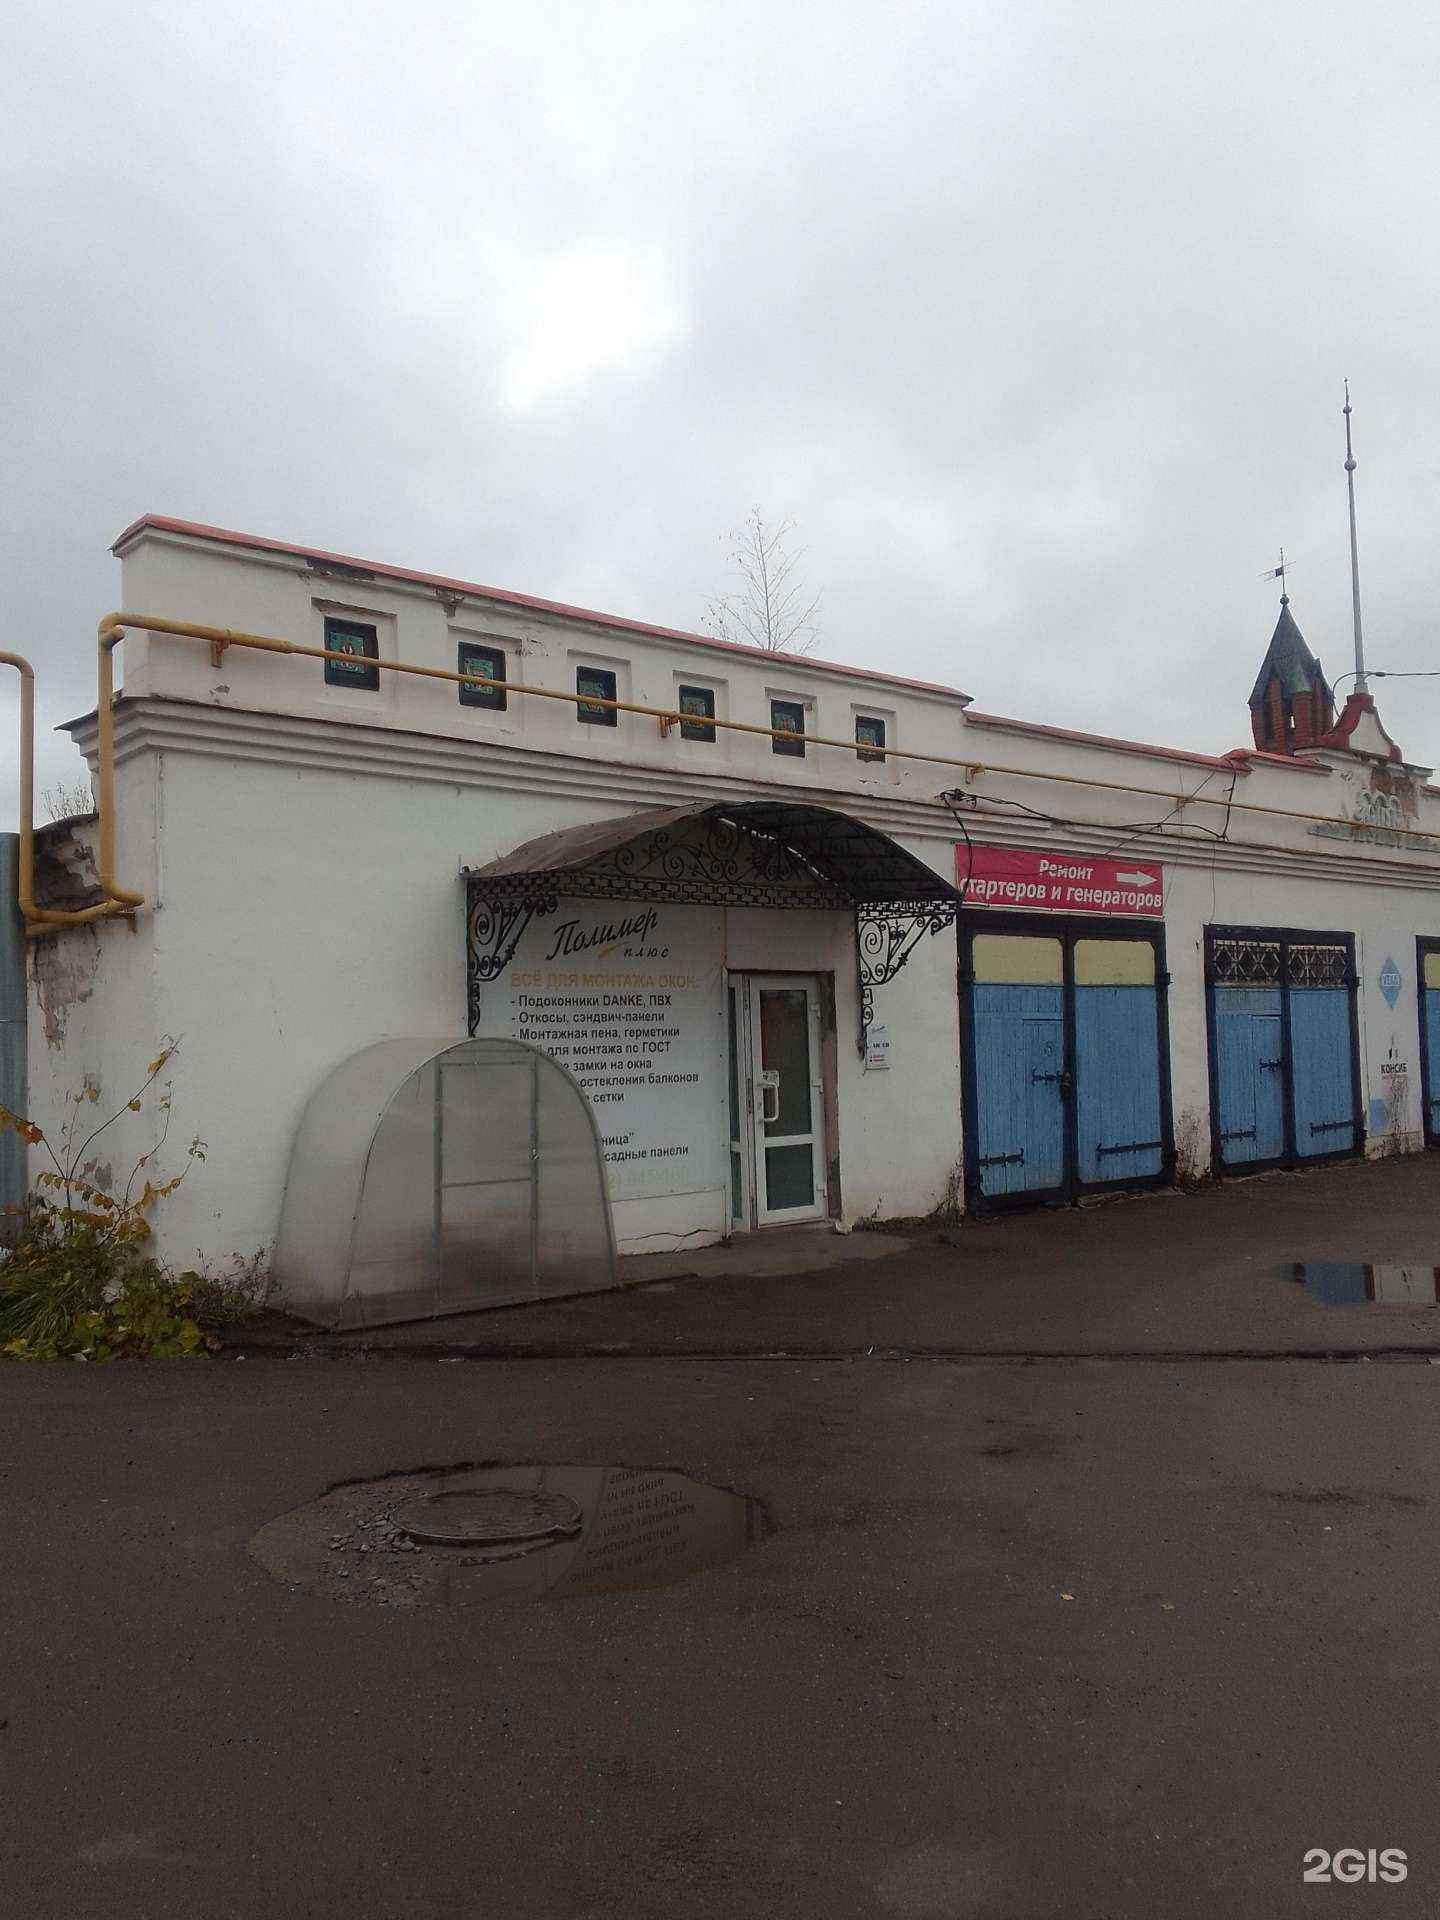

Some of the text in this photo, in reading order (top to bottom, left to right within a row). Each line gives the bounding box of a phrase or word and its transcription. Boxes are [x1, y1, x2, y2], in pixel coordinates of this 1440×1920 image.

[1039, 860, 1094, 880] Ремонт
[1051, 888, 1062, 900] и
[1066, 887, 1163, 908] генераторов
[546, 907, 658, 960] Полимер
[623, 948, 670, 959] плюс
[511, 970, 543, 988] ВСЁ
[548, 973, 578, 991] ДЛЯ
[582, 973, 654, 989] МОНТАЖА
[518, 995, 672, 1008] Подоконники DANKE, ПВХ
[518, 1011, 665, 1025] Откосы, сэндвич-панели
[519, 1028, 680, 1041] Монтажная пена, герметики
[547, 1046, 569, 1057] для
[572, 1045, 623, 1056] монтажа
[642, 1041, 671, 1054] ГОСТ
[572, 1063, 607, 1073] замки
[610, 1062, 623, 1071] на
[627, 1060, 652, 1070] окна
[580, 1073, 699, 1089] остекления балконов
[593, 1092, 625, 1103] сетки
[604, 1147, 689, 1162] садные панели
